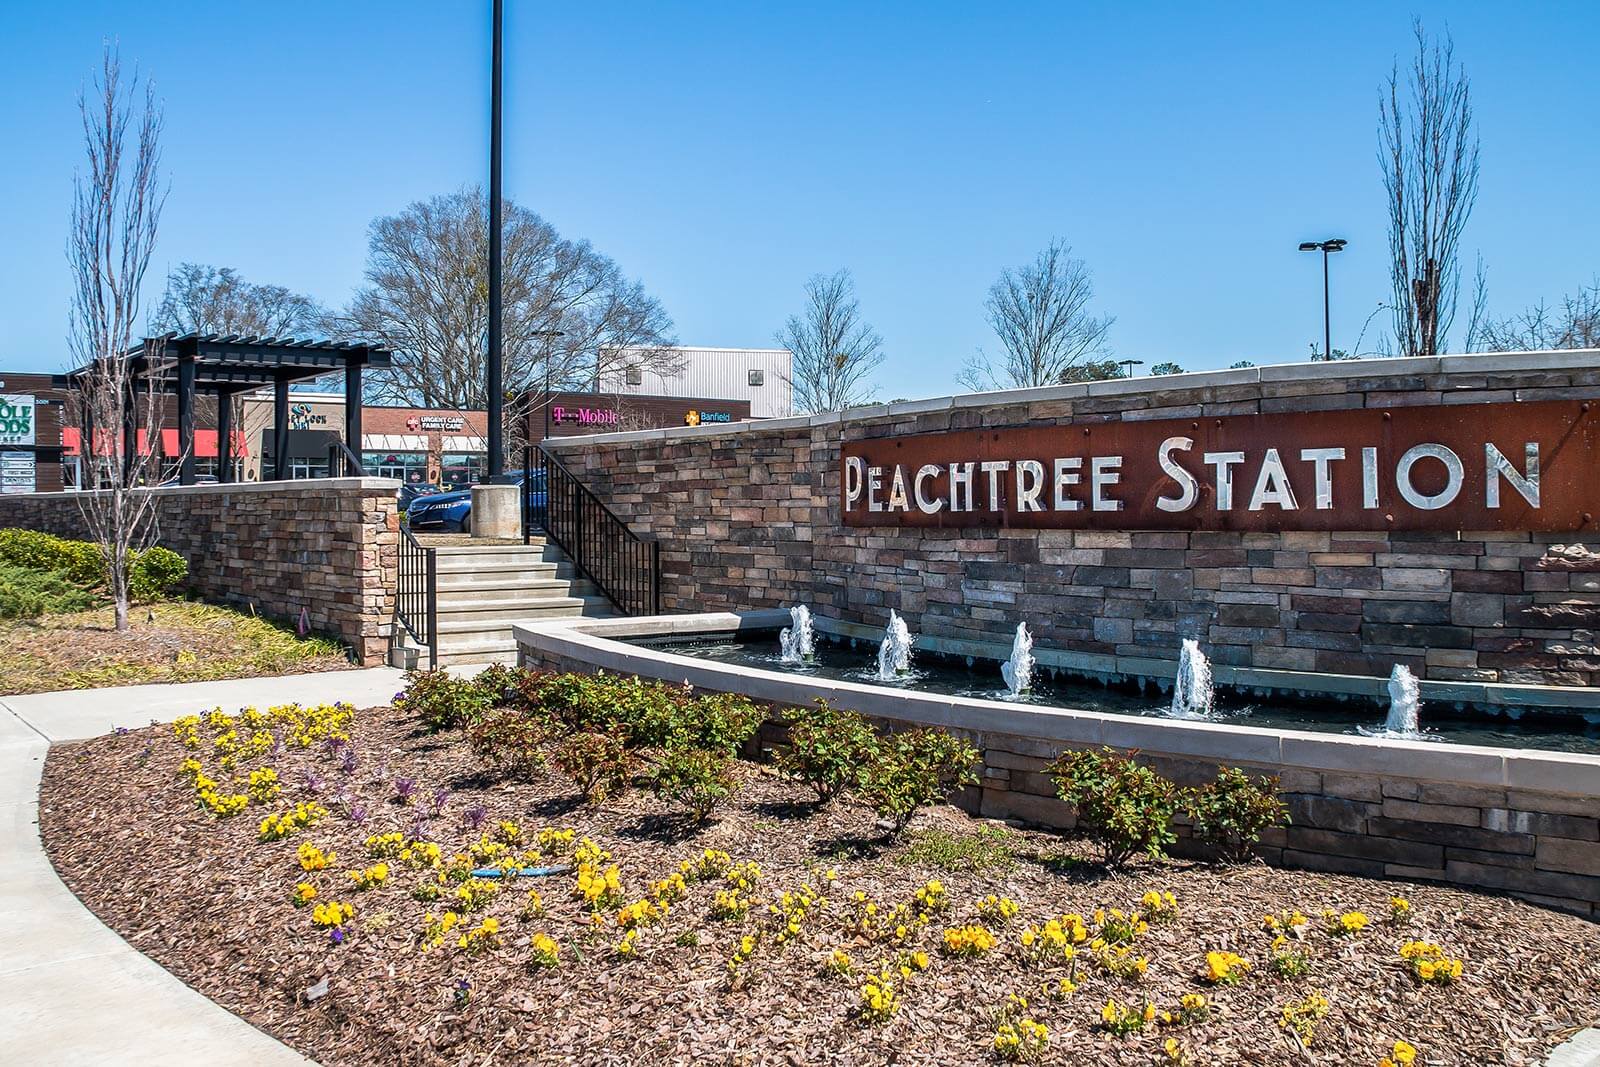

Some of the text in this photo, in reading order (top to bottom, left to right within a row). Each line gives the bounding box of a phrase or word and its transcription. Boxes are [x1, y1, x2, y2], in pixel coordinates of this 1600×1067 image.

[700, 411, 730, 422] Banfield
[845, 436, 1541, 514] PEACHTREE STATION
